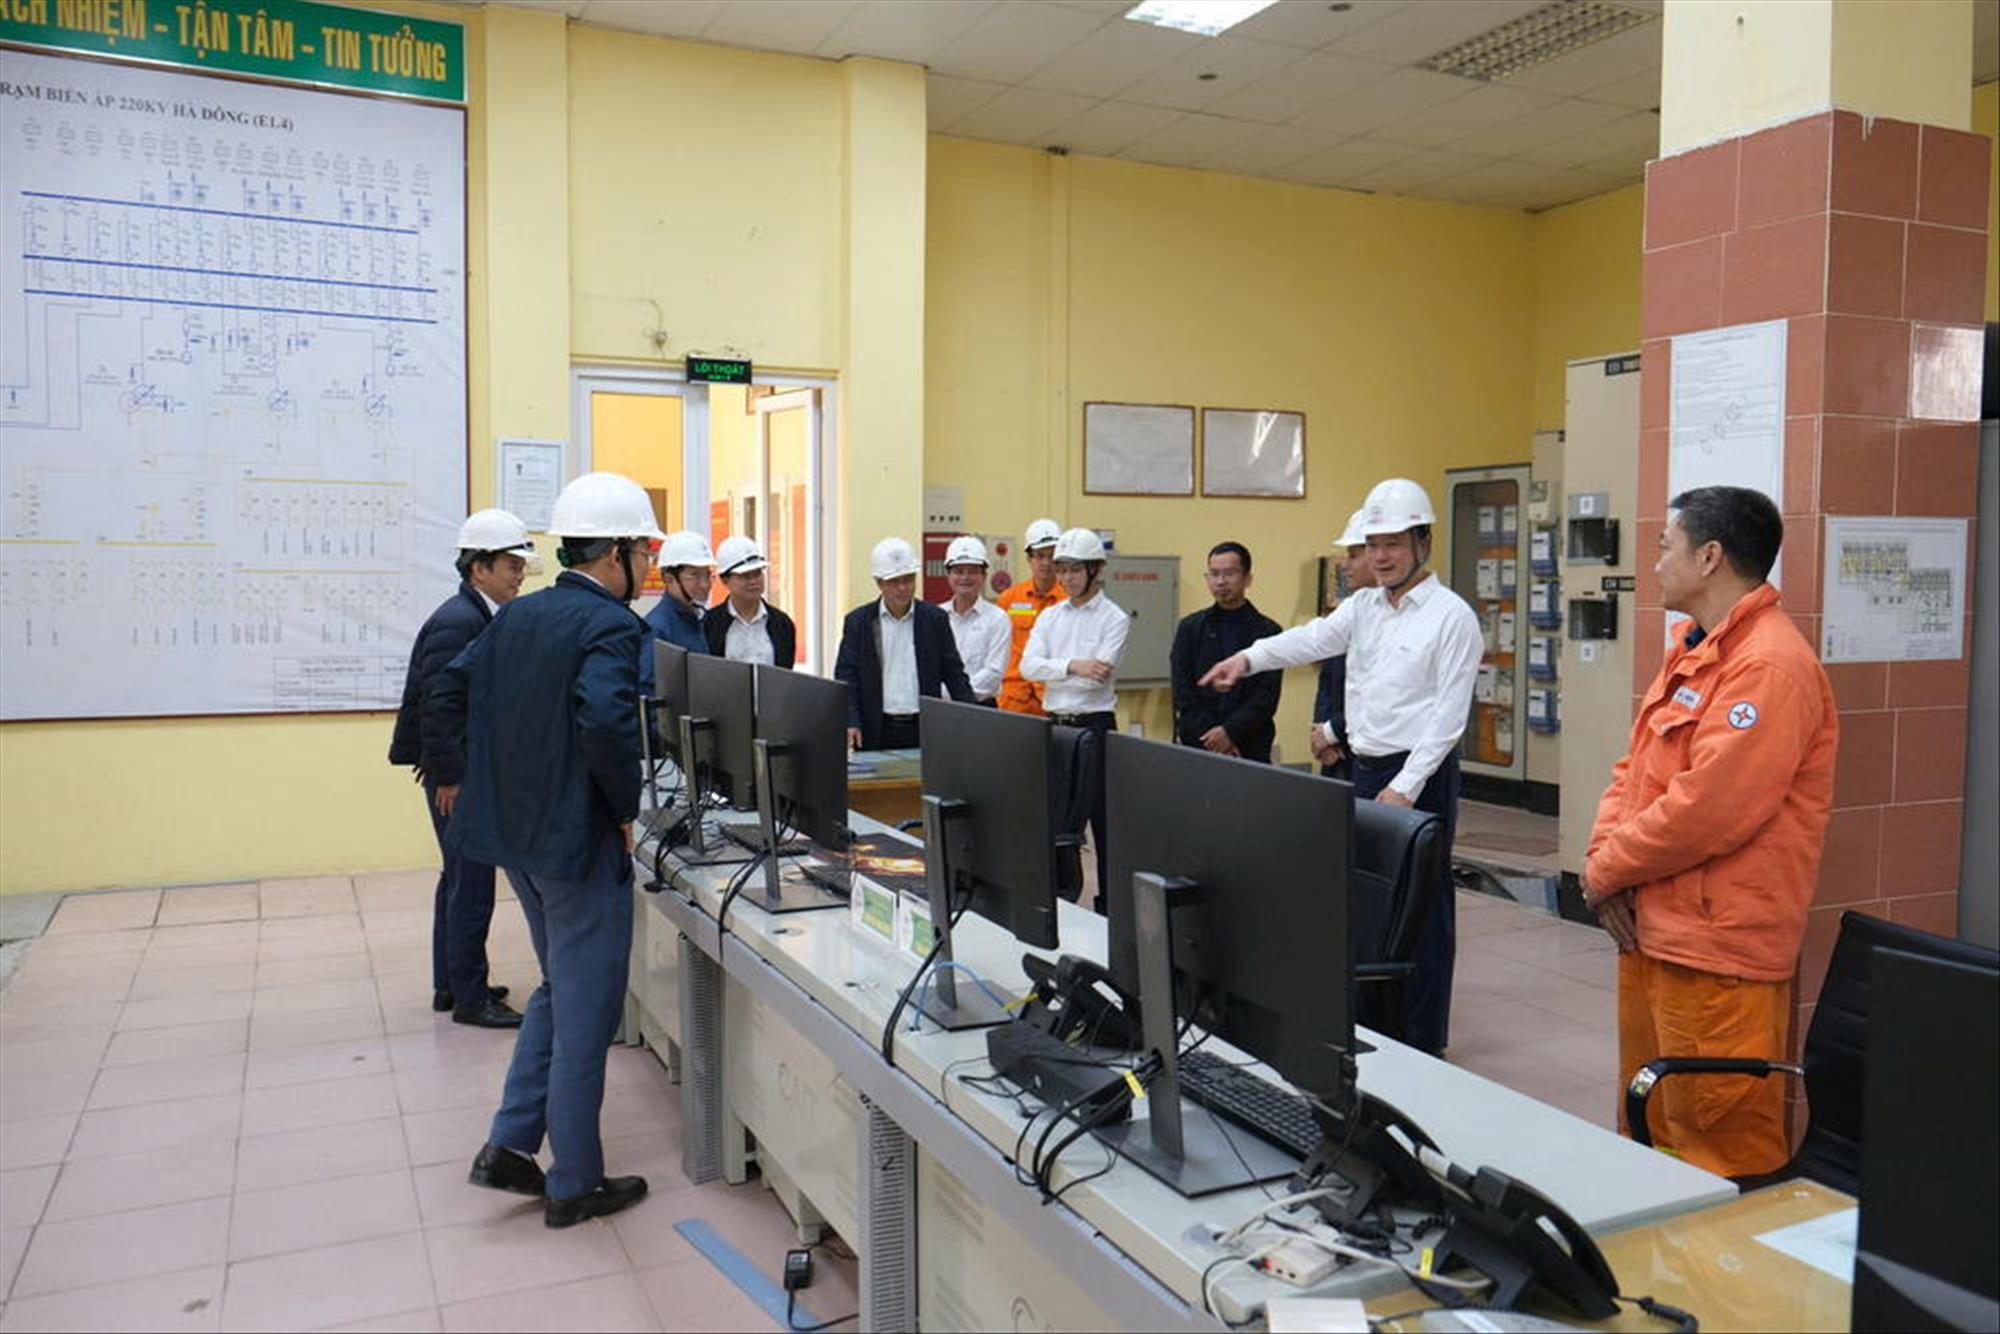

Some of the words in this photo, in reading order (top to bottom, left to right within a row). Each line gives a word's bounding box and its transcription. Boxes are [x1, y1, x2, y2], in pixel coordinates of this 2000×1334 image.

[176, 1, 229, 58] TẬN
[237, 9, 295, 61] TÂM
[321, 27, 361, 70] TIN
[368, 24, 447, 81] TƯỞNG
[202, 104, 249, 124] ĐÔNG
